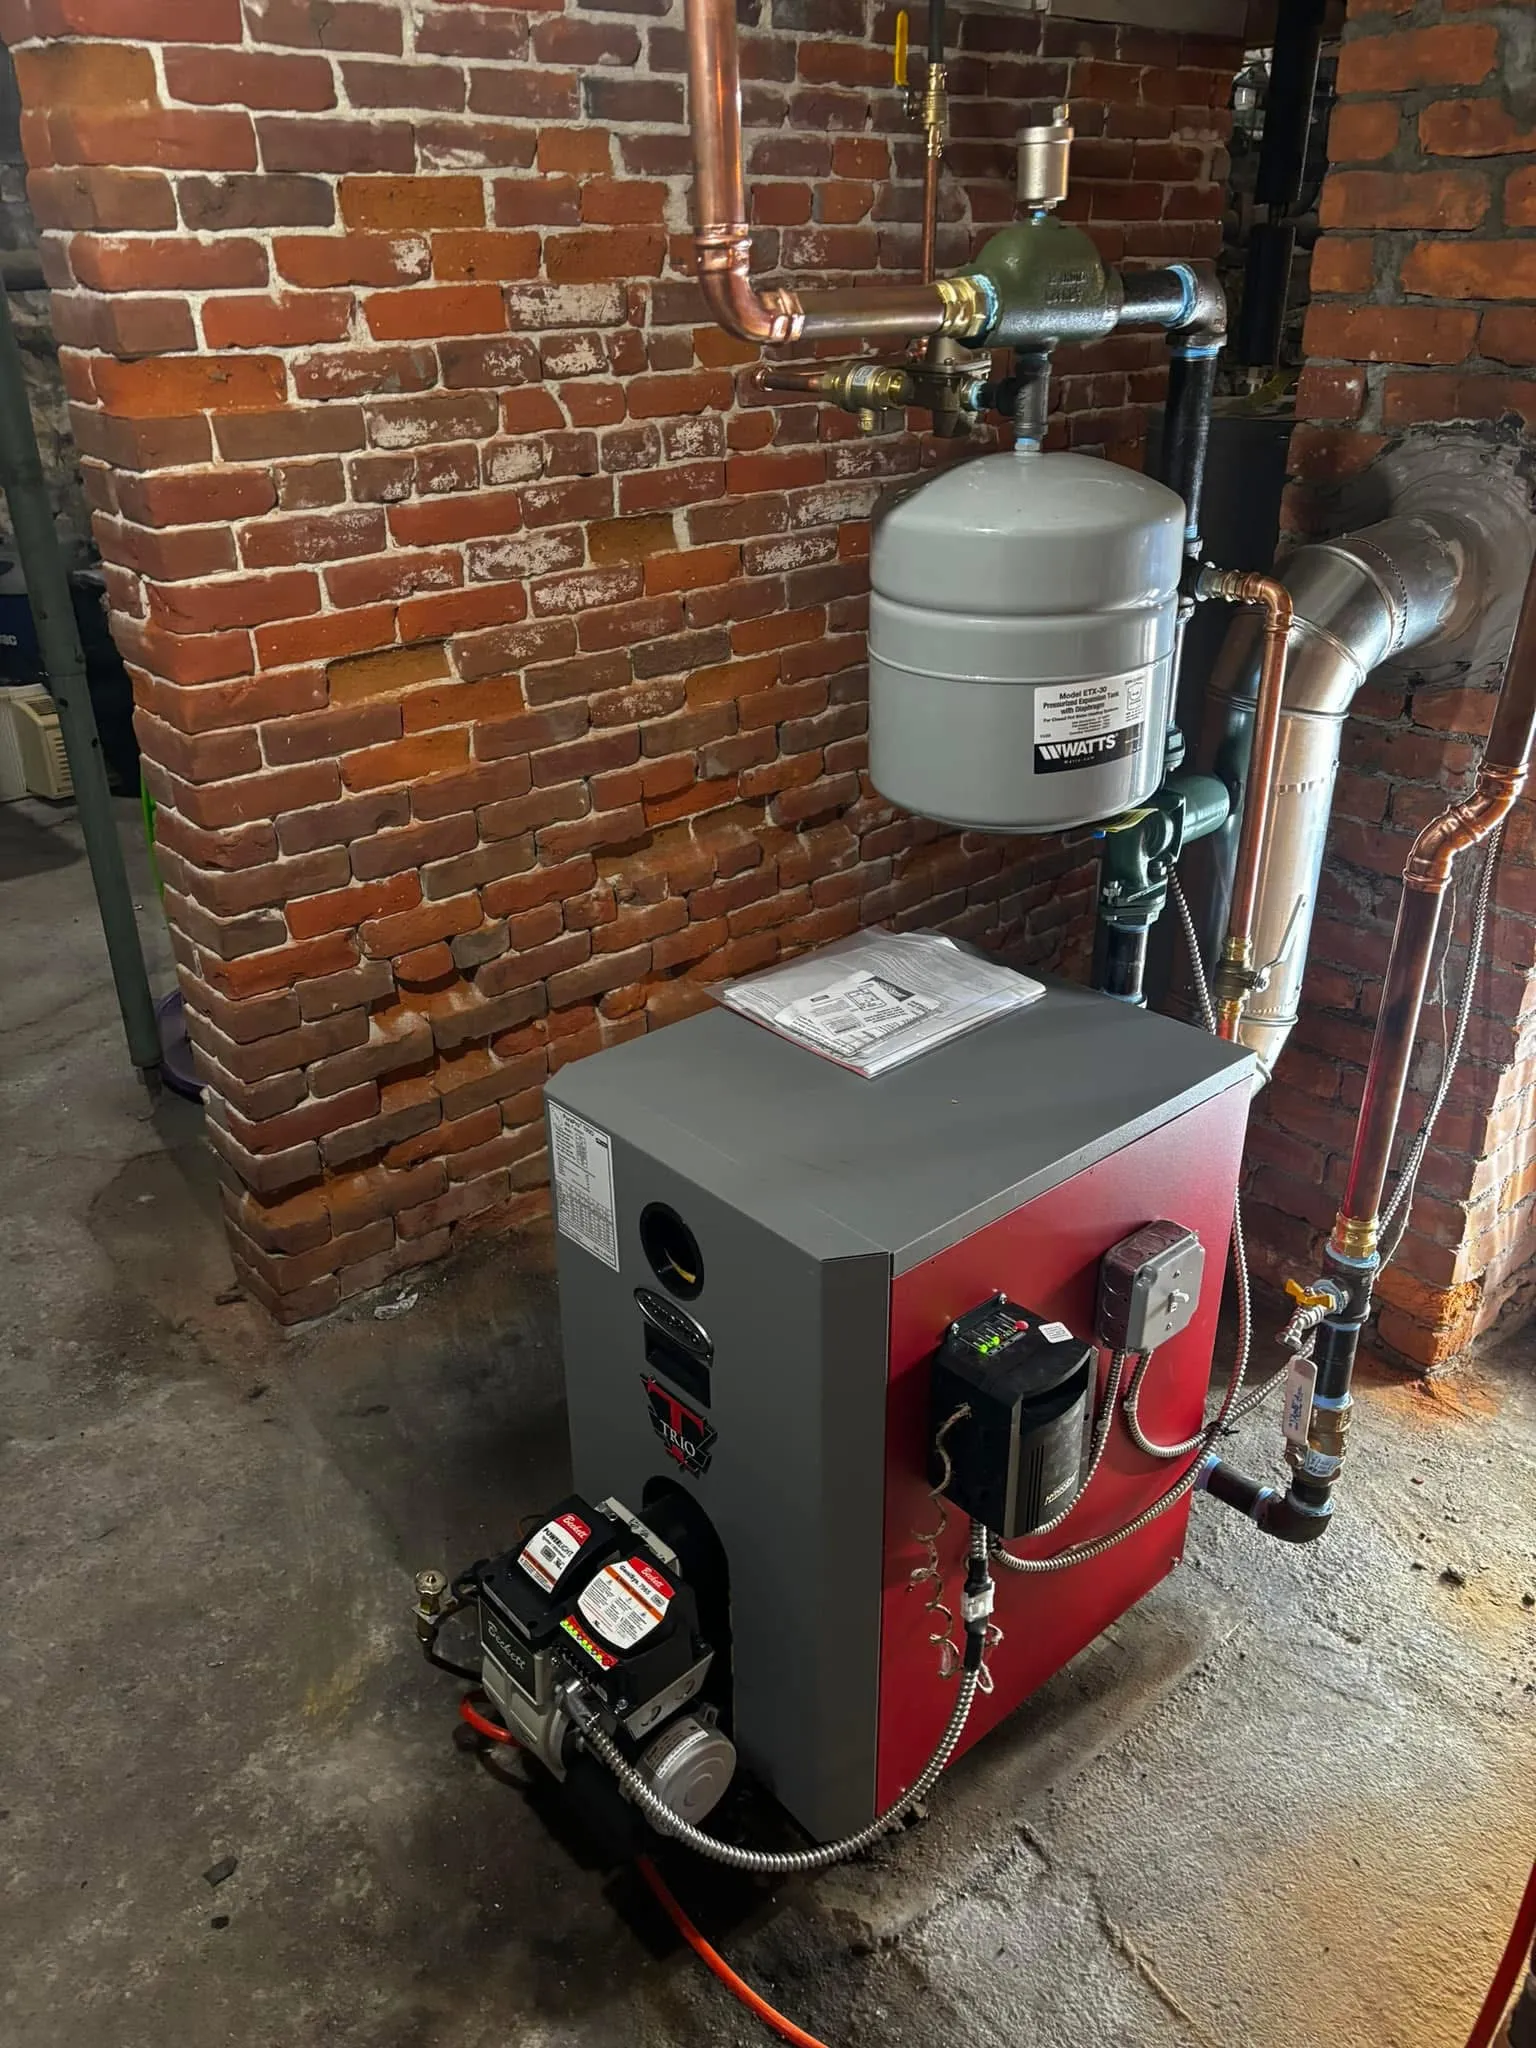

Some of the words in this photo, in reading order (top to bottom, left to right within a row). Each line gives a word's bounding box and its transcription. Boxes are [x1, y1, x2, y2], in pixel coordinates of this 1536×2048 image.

[1059, 690, 1082, 700] Model
[1082, 686, 1107, 697] ETX-30
[1075, 702, 1105, 713] Diaphragm
[1060, 733, 1117, 758] WATTS
[659, 1418, 697, 1457] TRIO
[563, 1515, 588, 1539] Beckett
[641, 1566, 665, 1588] Beckett
[487, 1620, 526, 1670] Beckett
